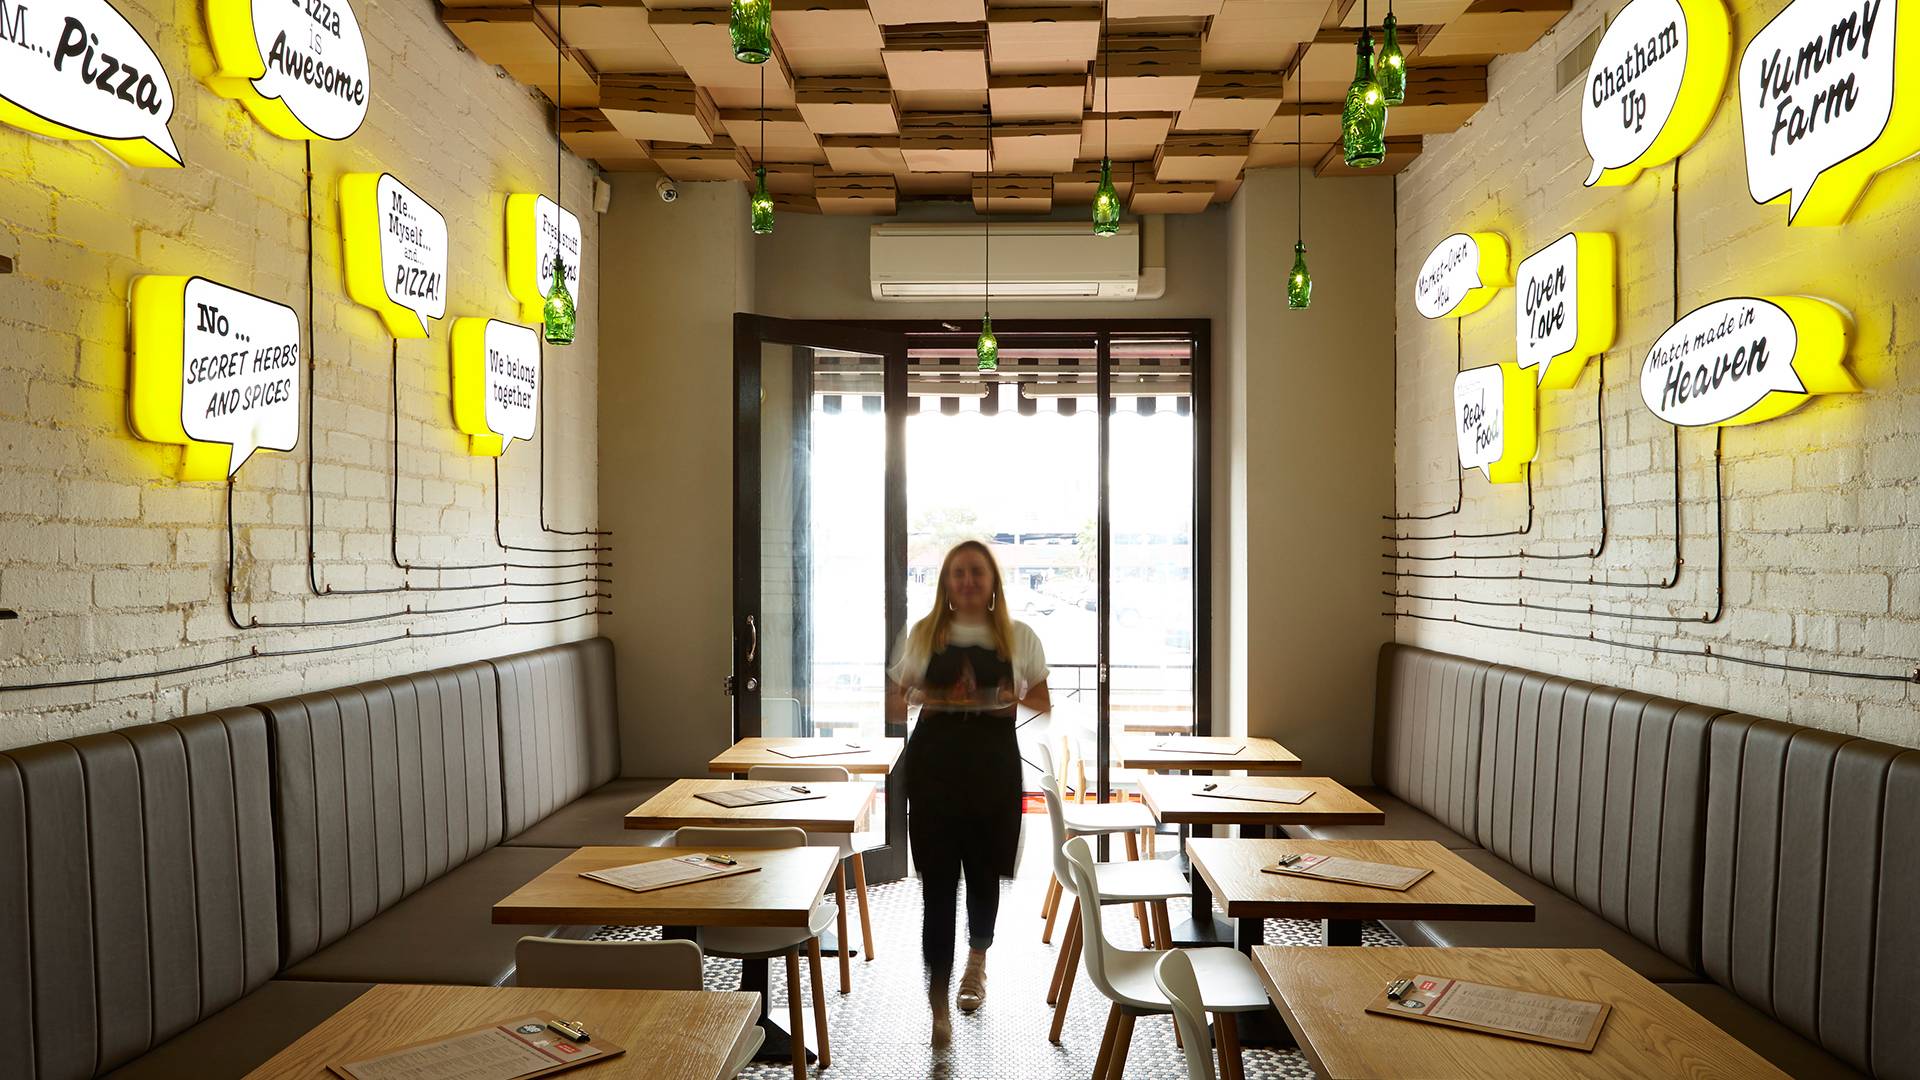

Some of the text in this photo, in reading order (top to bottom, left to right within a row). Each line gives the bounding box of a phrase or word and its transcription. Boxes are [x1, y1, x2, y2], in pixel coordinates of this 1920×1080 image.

[291, 0, 341, 39] izza
[309, 23, 322, 55] is
[53, 16, 163, 115] Pizza
[268, 29, 365, 106] Awesome
[1592, 21, 1679, 108] Chatham
[1759, 0, 1881, 109] Yummy
[1621, 89, 1646, 134] Up
[1770, 72, 1859, 156] Farm
[392, 190, 417, 222] Me...
[388, 212, 432, 252] Myself...
[395, 264, 441, 301] PIZZA!
[541, 253, 577, 282] Gaens
[1526, 264, 1567, 316] Oven
[1649, 306, 1755, 374] Match made in
[187, 343, 298, 385] SECRET HERBS
[489, 349, 536, 390] We belong
[1661, 336, 1770, 412] Heaven
[205, 378, 291, 419] AND SPICES
[493, 379, 532, 410] together
[1463, 387, 1485, 434] Real
[1476, 408, 1499, 455] Food
